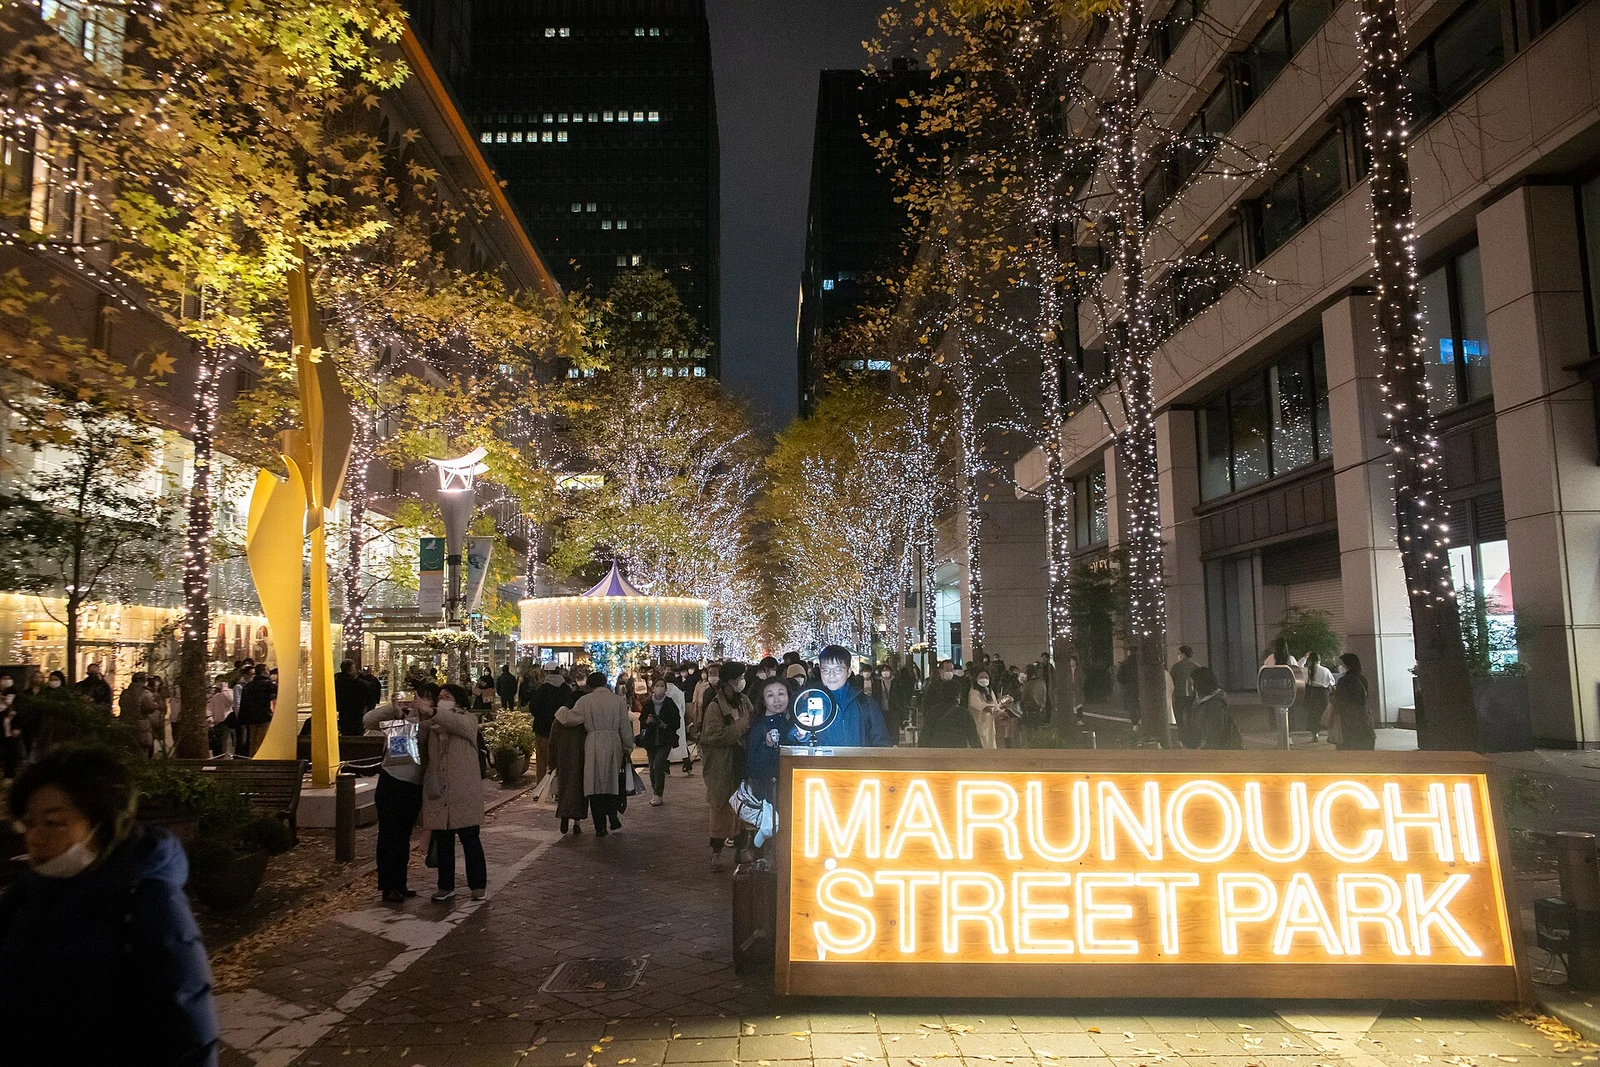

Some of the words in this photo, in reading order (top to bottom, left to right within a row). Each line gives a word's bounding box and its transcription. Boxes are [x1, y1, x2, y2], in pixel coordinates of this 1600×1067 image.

[803, 777, 1481, 863] MARUNOUCHI
[813, 868, 1201, 957] STREET
[1216, 871, 1482, 959] PARK
